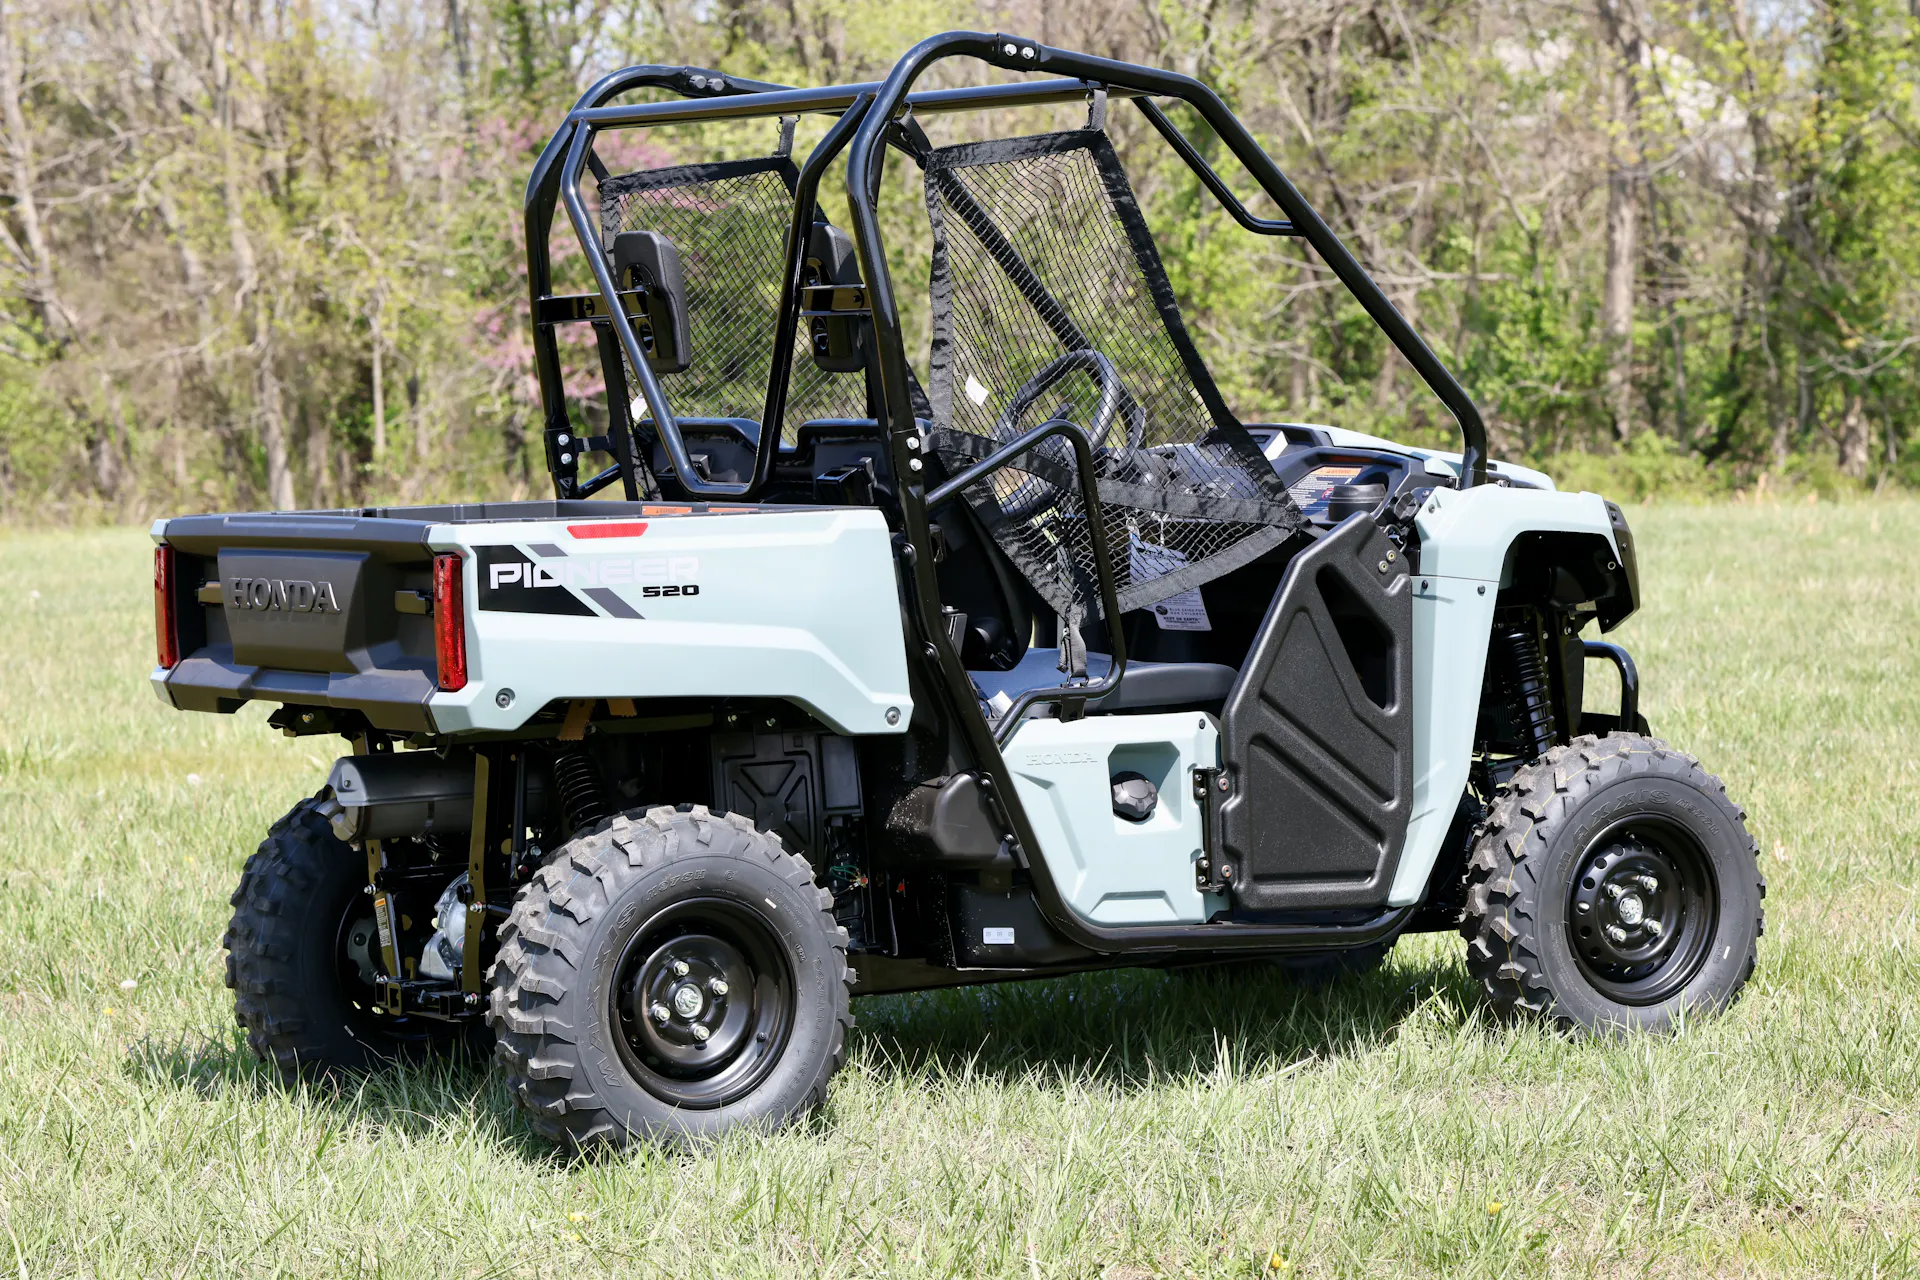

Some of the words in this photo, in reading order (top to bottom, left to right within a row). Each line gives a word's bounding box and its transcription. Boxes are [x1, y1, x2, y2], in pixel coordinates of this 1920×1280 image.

[489, 556, 700, 590] PIONEER
[228, 576, 342, 614] HONDA
[642, 584, 700, 598] 520
[1026, 752, 1098, 766] HONDA
[1555, 788, 1671, 884] MAXXIS
